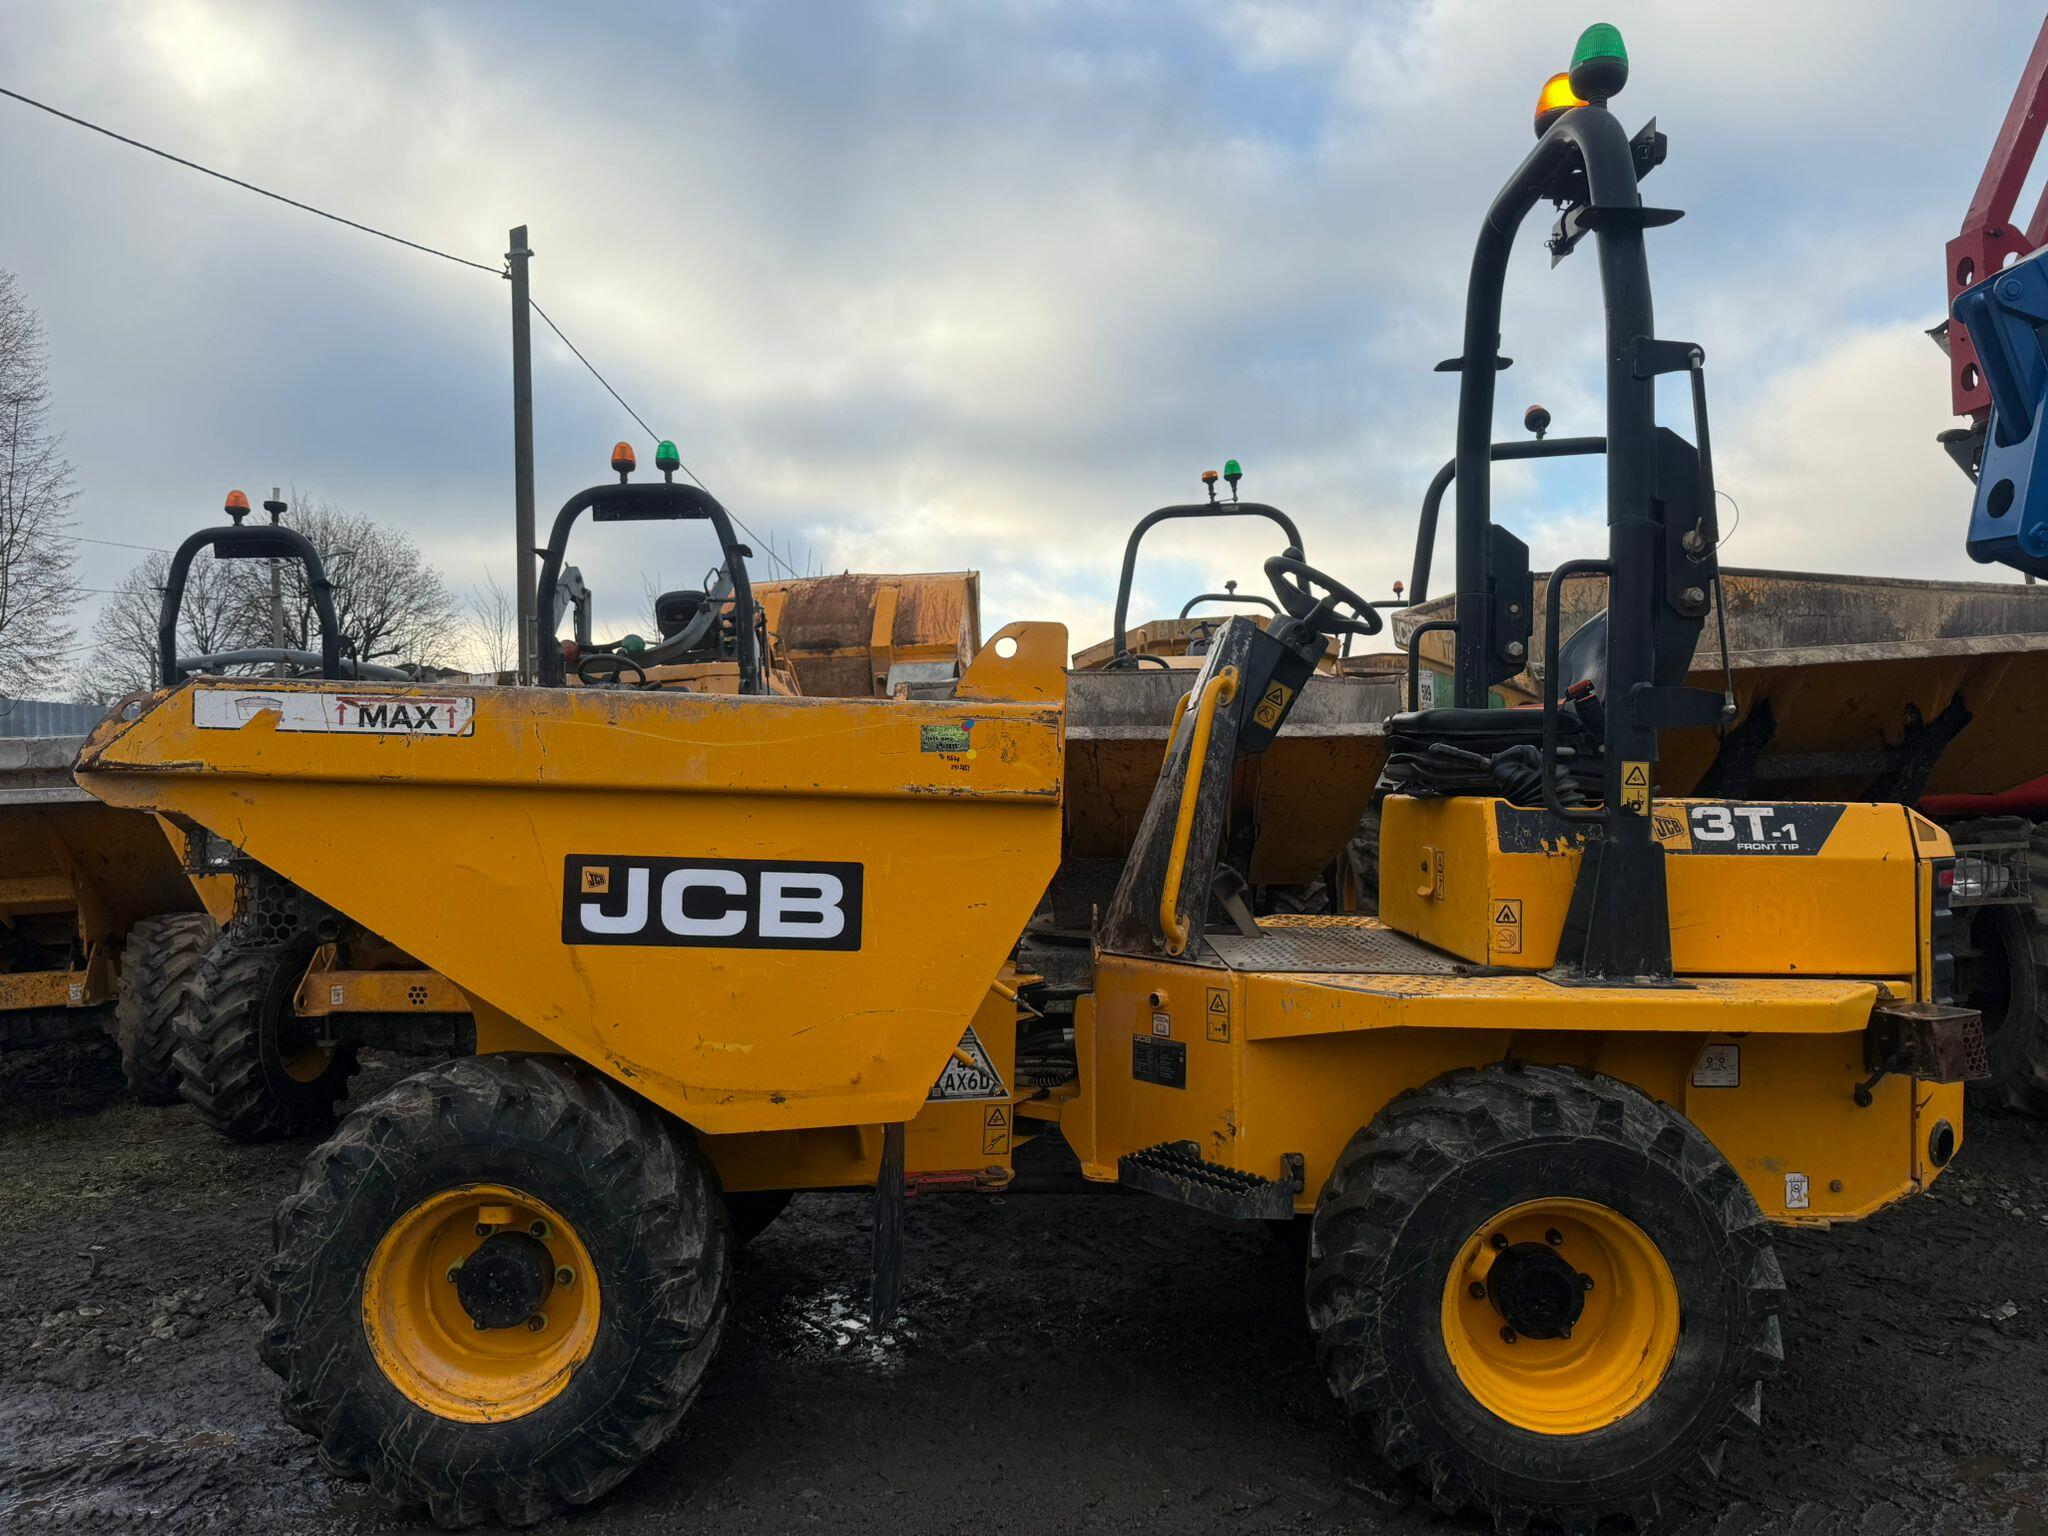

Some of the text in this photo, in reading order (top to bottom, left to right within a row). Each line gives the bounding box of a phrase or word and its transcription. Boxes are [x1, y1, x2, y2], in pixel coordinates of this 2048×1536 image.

[358, 704, 438, 730] MAX
[1654, 817, 1683, 836] JCB
[1736, 842, 1799, 851] FRONT TIP
[588, 872, 606, 887] JCB
[579, 866, 846, 940] JCB
[1133, 1033, 1152, 1044] JCB
